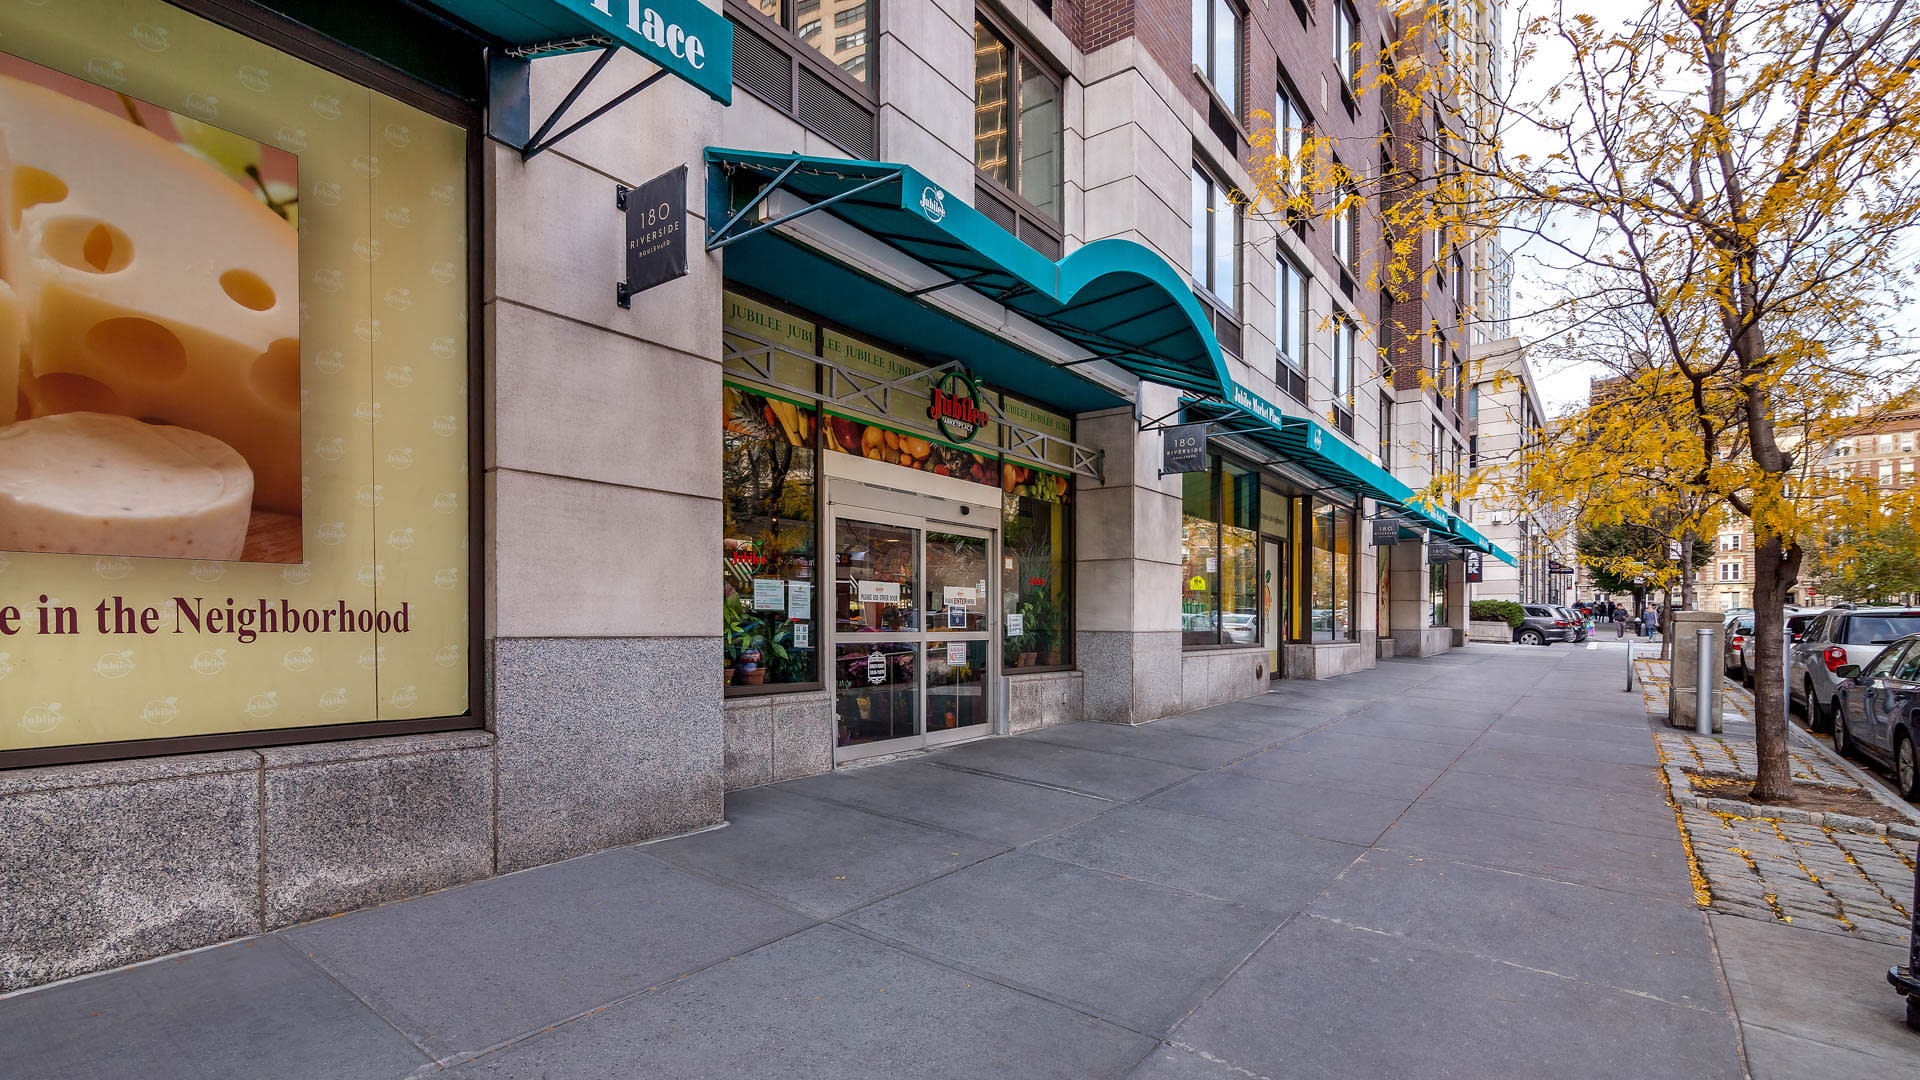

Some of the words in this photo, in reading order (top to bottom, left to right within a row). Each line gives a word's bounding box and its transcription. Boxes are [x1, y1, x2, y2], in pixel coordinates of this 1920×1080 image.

[591, 0, 704, 69] lace
[641, 202, 670, 229] 180
[920, 192, 946, 218] Jubilee
[630, 220, 679, 249] RIVERSIDE
[639, 240, 671, 258] BOULEVARD
[730, 303, 783, 333] JUBILEE
[844, 344, 884, 369] JUBILEE
[930, 387, 989, 427] Jubilee
[1234, 387, 1252, 410] Jubilee
[1253, 397, 1269, 419] Market
[1269, 406, 1281, 426] Place
[1166, 447, 1202, 456] RIVERSIDE
[1174, 437, 1196, 448] 180
[731, 551, 767, 566] Jubilee
[1467, 549, 1480, 574] ARK
[36, 594, 80, 635] in
[94, 596, 159, 635] the
[172, 597, 410, 643] Neighborhood
